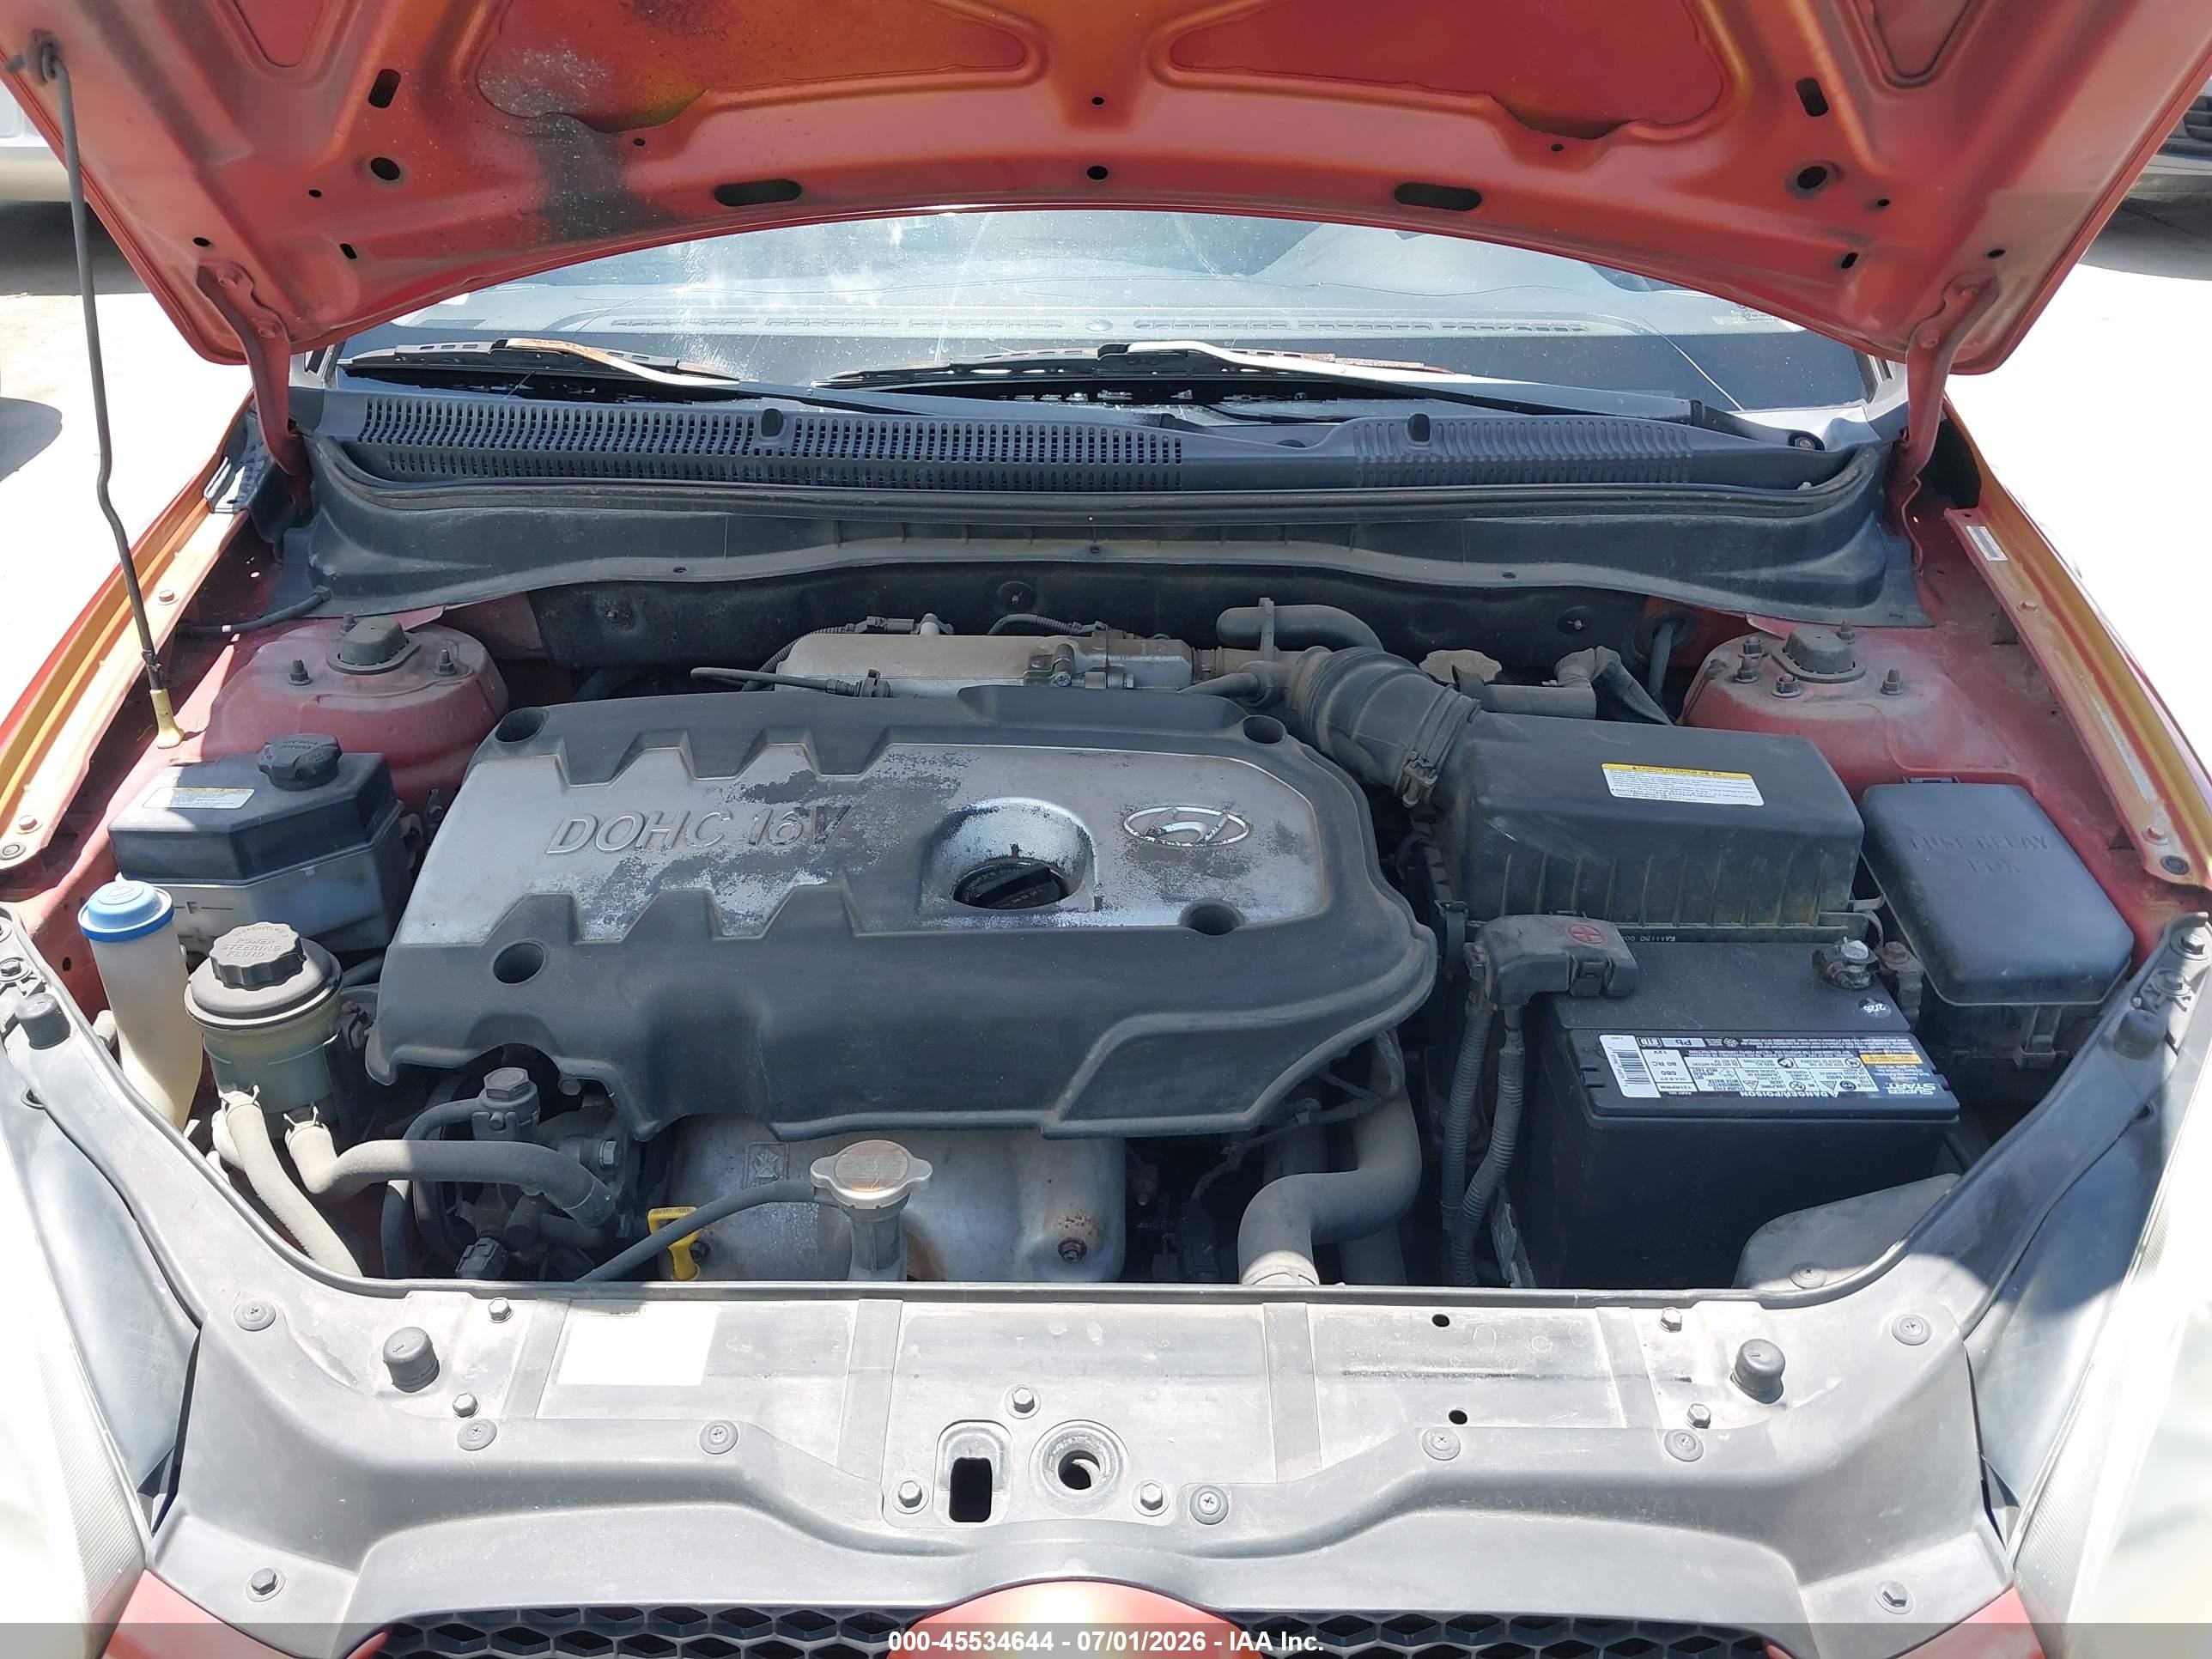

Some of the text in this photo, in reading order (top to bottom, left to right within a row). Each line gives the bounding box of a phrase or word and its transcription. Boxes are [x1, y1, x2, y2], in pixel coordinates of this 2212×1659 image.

[545, 805, 853, 855] DOHC 16V
[221, 944, 282, 952] STEERING
